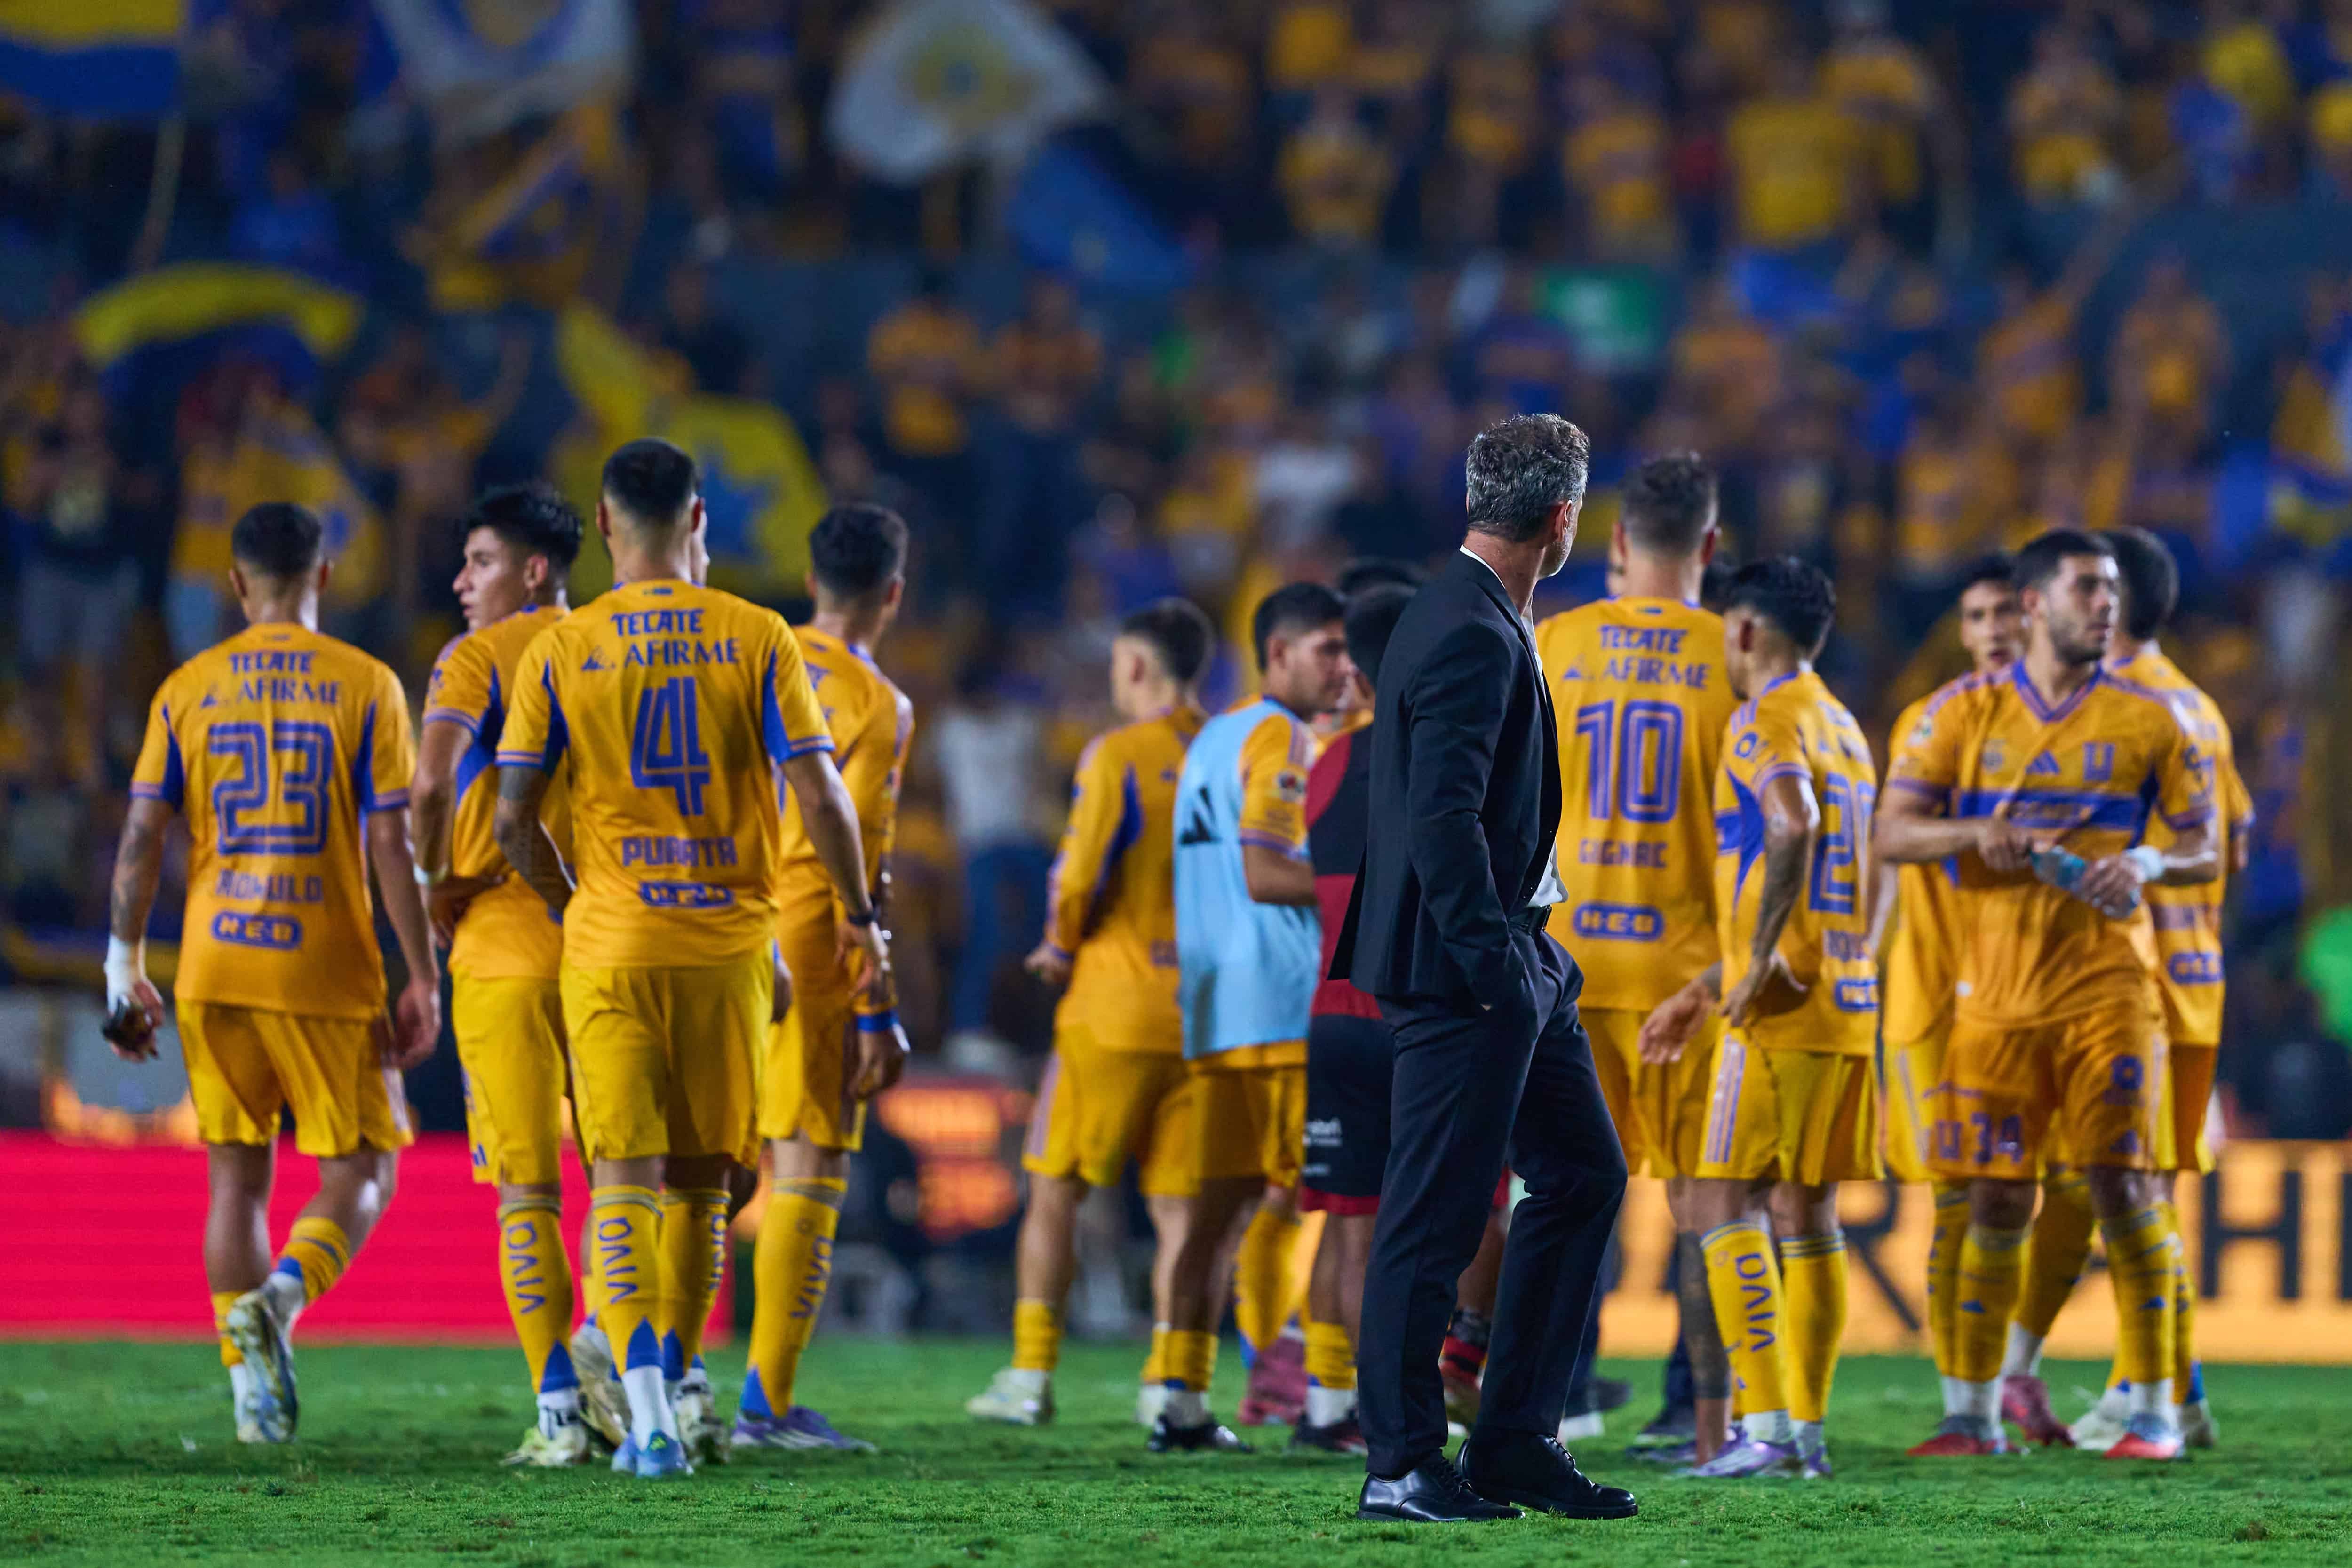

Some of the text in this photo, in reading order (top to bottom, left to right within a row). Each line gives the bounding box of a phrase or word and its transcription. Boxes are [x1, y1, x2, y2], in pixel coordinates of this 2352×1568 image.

[611, 609, 704, 636] TECATE
[625, 638, 741, 668] AFIRME
[1597, 624, 1688, 653] TECATE
[228, 650, 318, 673] TECATE
[1603, 656, 1711, 690] AFIRME
[238, 677, 342, 704] AFIRME
[631, 677, 710, 816] 4
[1576, 700, 1683, 823] 10
[208, 719, 334, 855] 23
